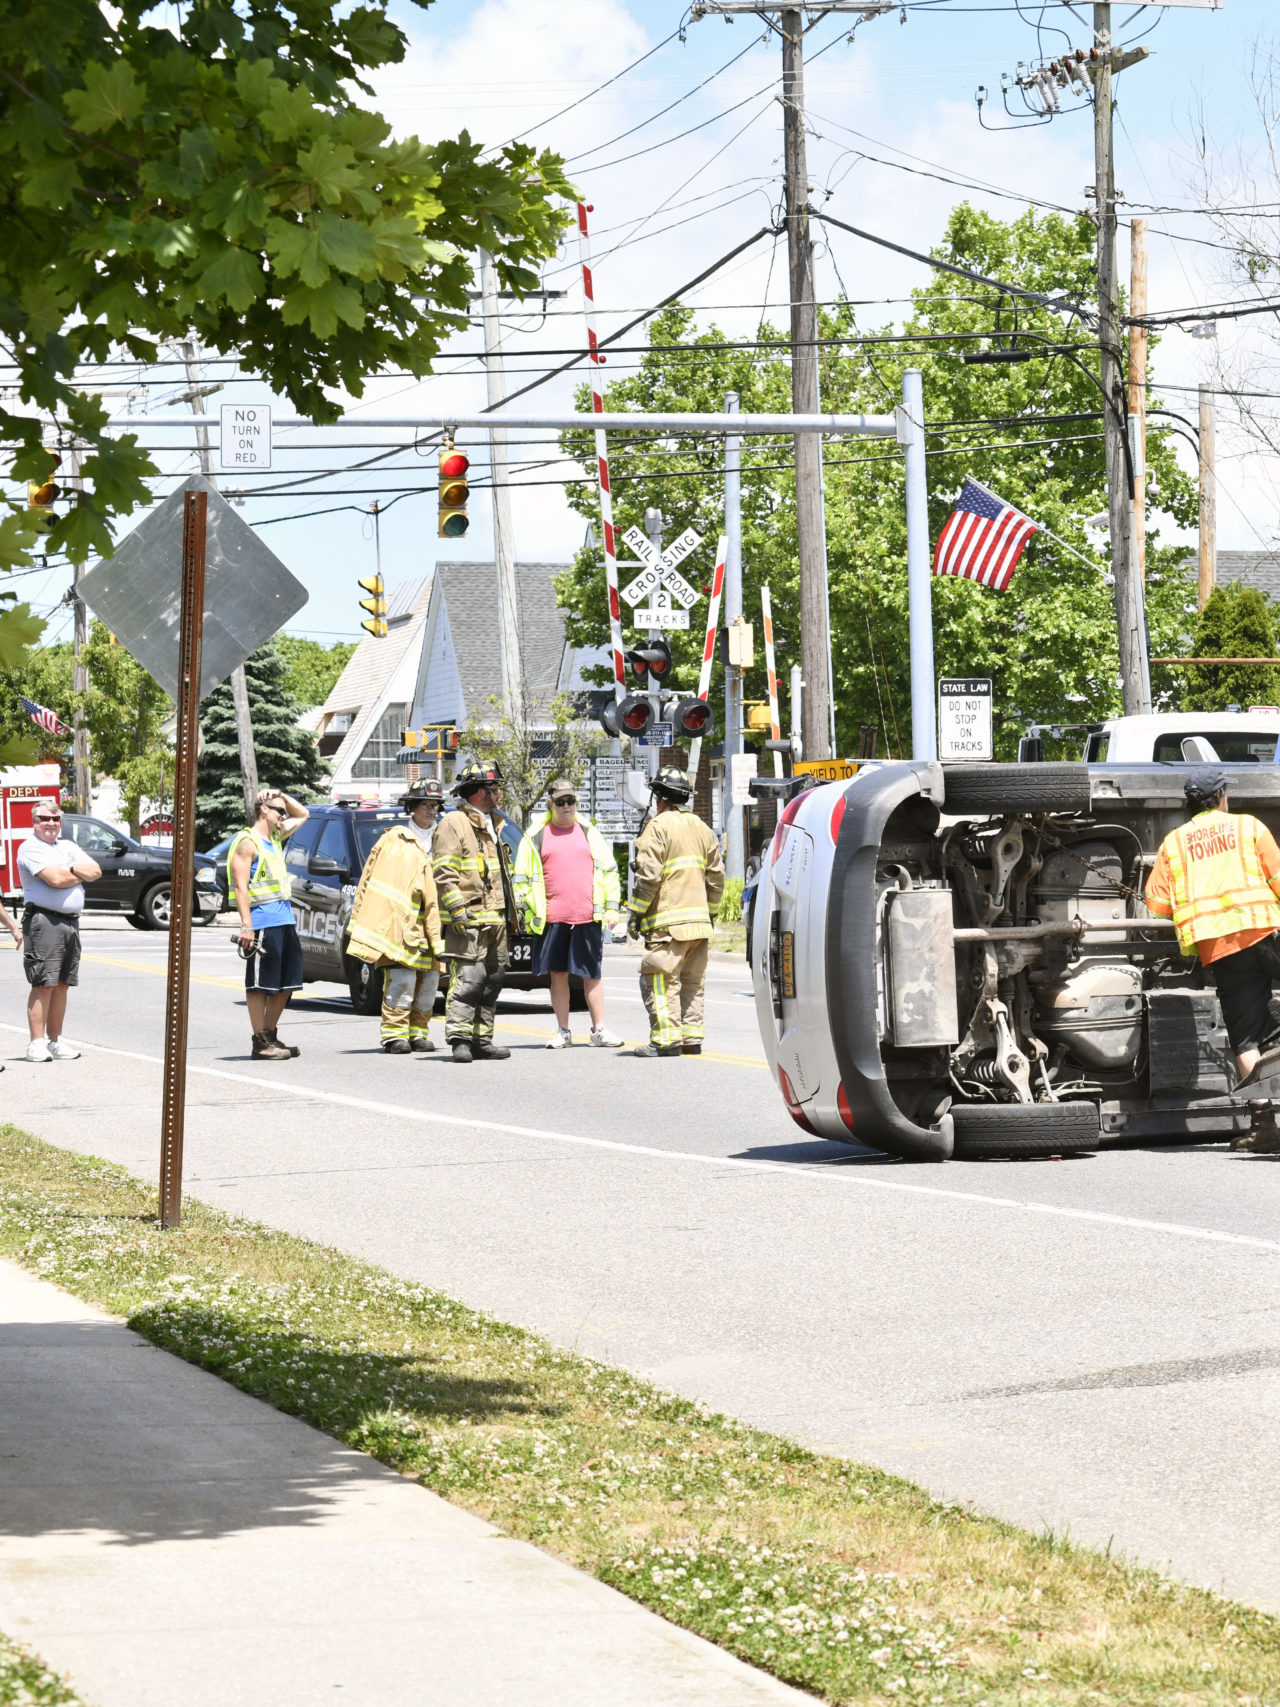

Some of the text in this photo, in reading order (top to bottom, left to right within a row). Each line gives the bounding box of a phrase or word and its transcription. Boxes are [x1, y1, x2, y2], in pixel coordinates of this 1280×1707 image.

[235, 410, 257, 422] NO
[232, 425, 261, 436] TURN
[238, 439, 254, 449] ON
[235, 452, 257, 463] RED
[626, 529, 695, 605] RAIL ROAD
[628, 535, 695, 600] CROSSING
[657, 594, 667, 608] 2
[637, 614, 687, 625] TRACKS
[942, 683, 989, 694] STATE LAW
[949, 700, 982, 711] DO NOT
[955, 714, 977, 725] STOP
[960, 728, 972, 738] ON
[950, 741, 983, 752] TRACKS
[810, 766, 853, 780] YIELD TO
[1187, 833, 1236, 863] TOWING
